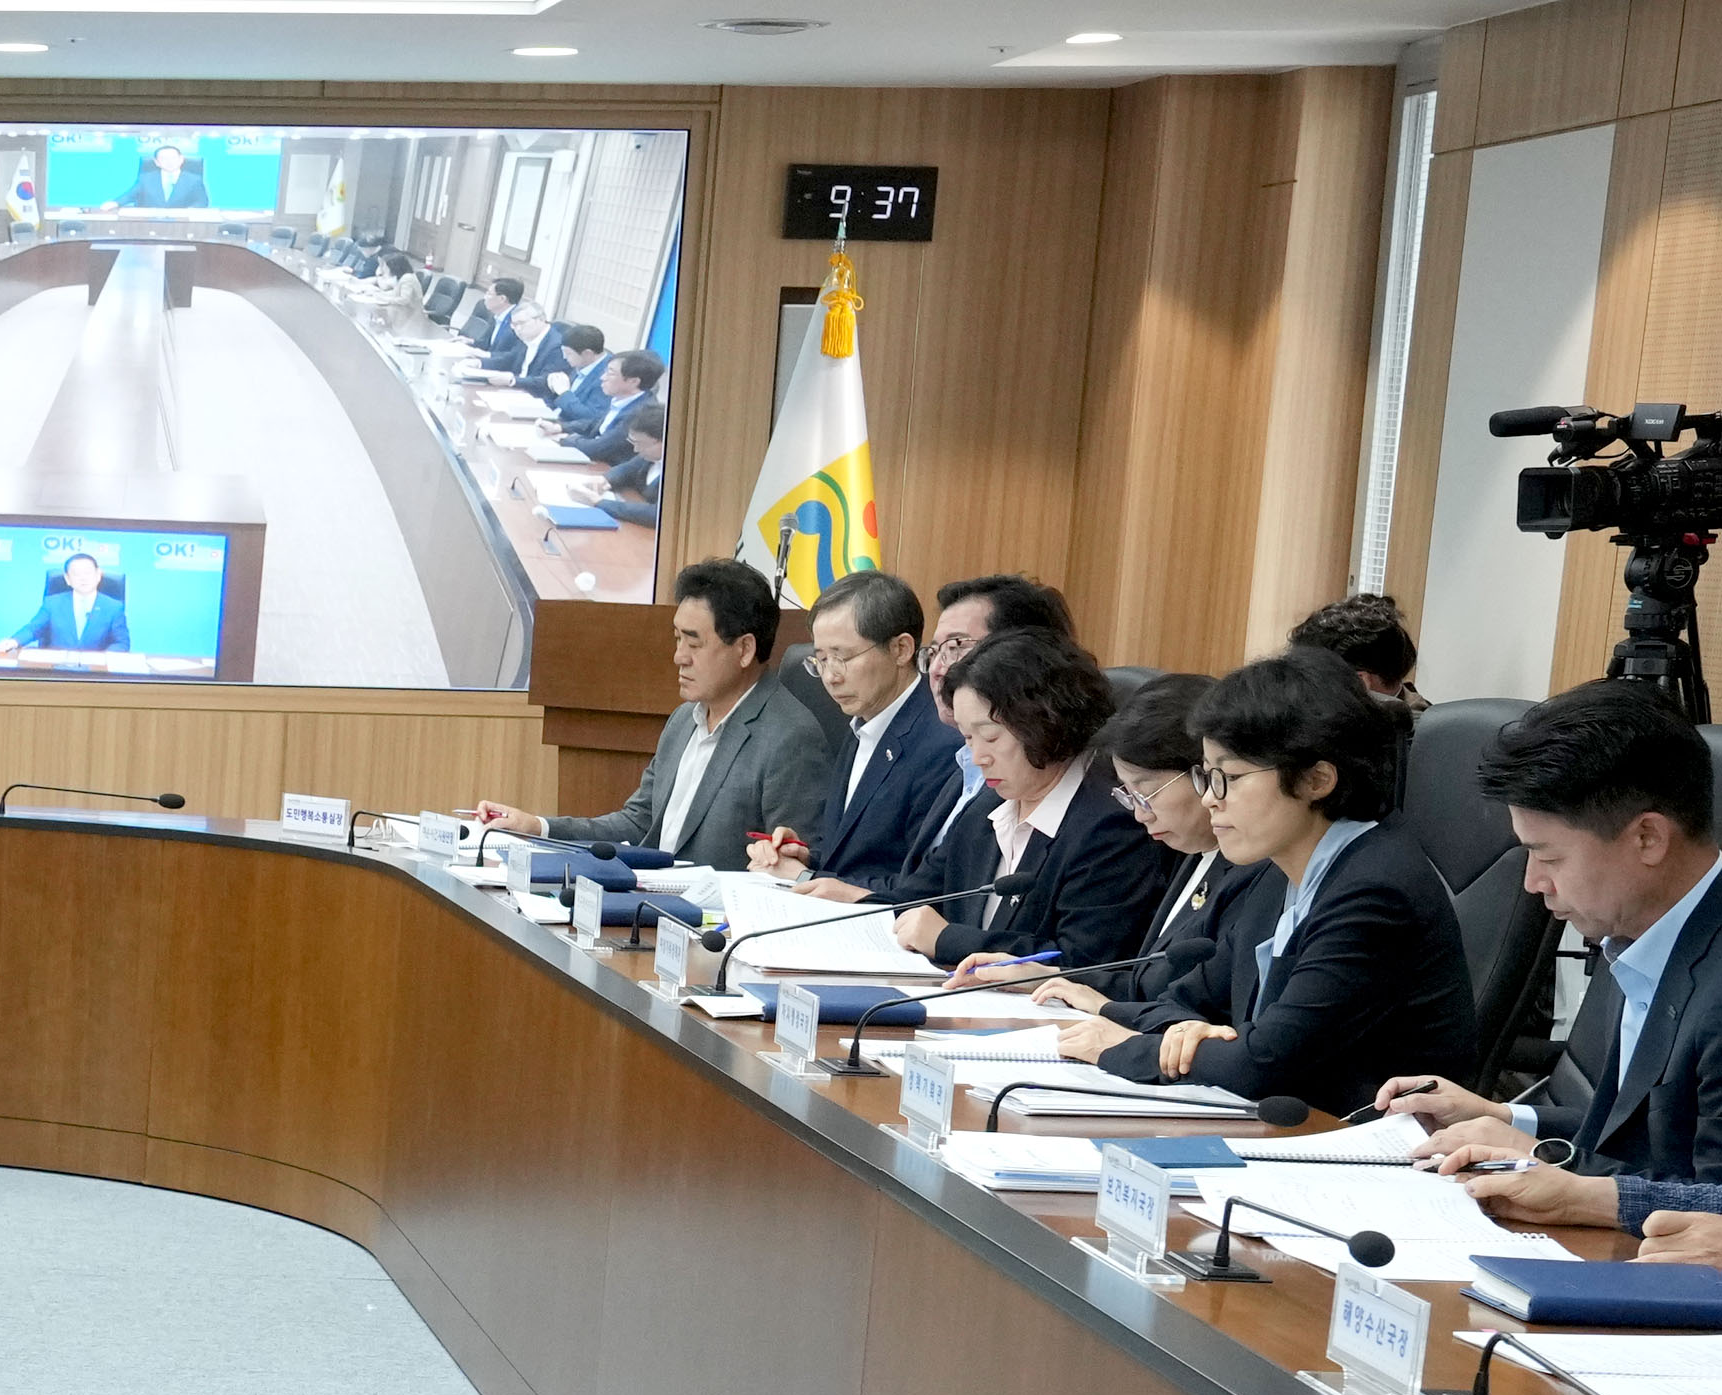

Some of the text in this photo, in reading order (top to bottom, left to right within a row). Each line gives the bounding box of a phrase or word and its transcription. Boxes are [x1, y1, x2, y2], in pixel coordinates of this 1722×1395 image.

[828, 185, 920, 220] 9:37
[285, 807, 343, 826] 도민행복소통실장
[1106, 1175, 1155, 1221] 보건복지국장
[1342, 1299, 1409, 1358] 해양수산국장
